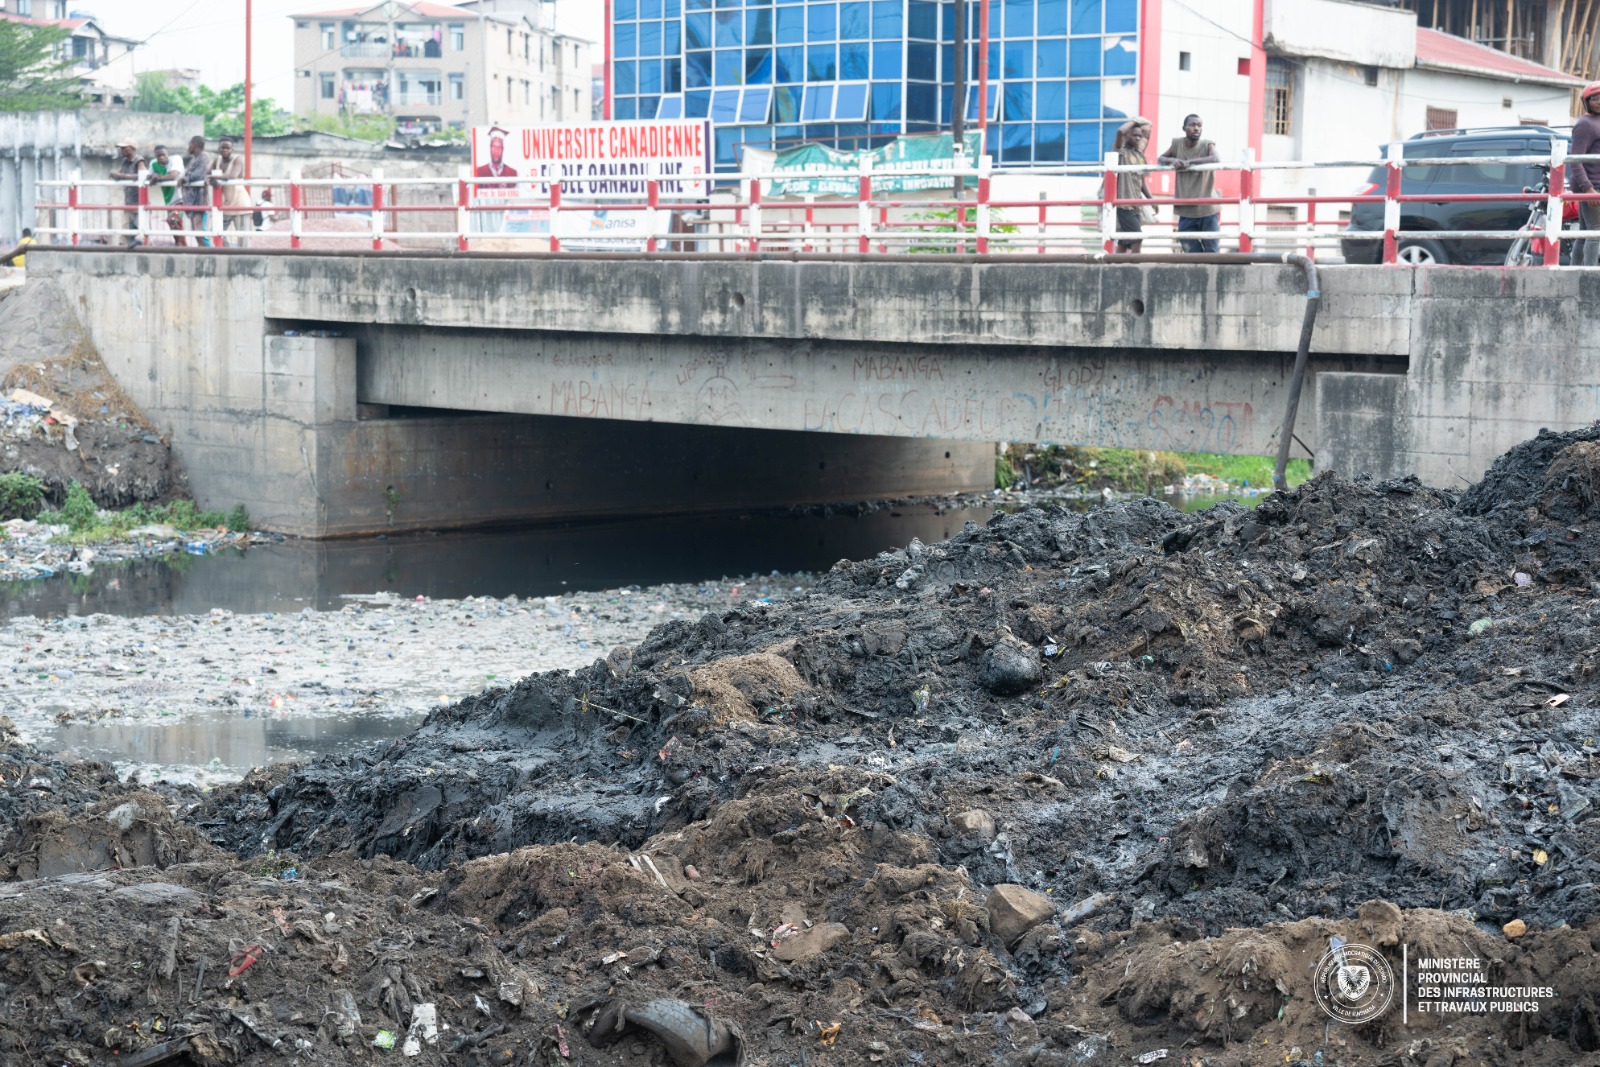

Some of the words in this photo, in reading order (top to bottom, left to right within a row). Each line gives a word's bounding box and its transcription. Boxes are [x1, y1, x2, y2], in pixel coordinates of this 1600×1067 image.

[522, 127, 605, 160] UNIVERSITE
[609, 124, 702, 159] CANADIENNE
[541, 163, 584, 194] EOLE
[606, 219, 636, 230] anisa
[853, 355, 944, 382] MABANGA
[1044, 361, 1105, 392] GLODY
[551, 380, 652, 419] MABANGA
